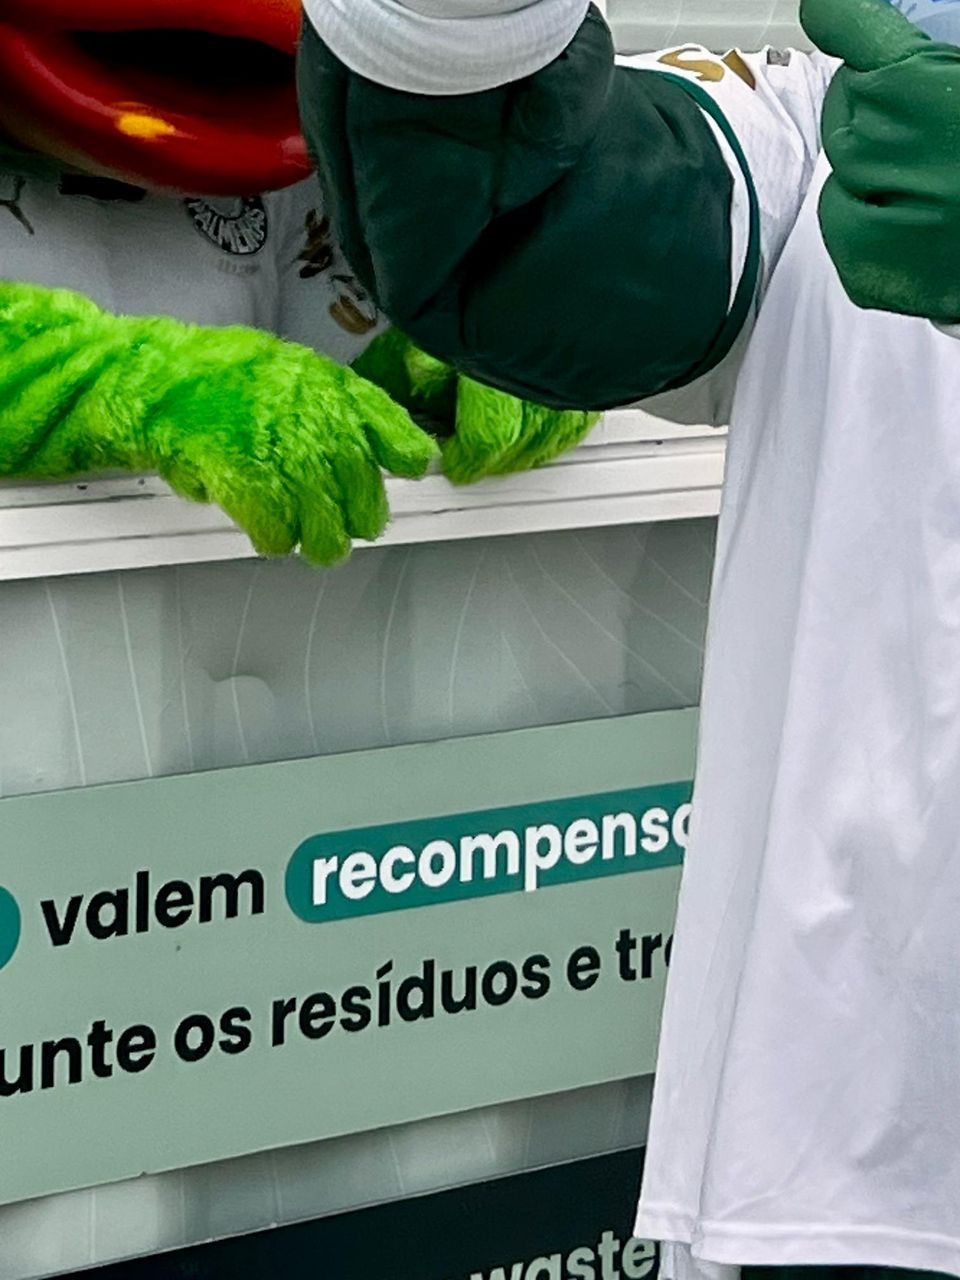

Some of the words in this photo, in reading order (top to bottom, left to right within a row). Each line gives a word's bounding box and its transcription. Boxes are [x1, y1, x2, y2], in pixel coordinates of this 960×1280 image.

[40, 867, 265, 947] valem
[173, 1005, 252, 1064] os
[271, 953, 551, 1047] resíduos
[566, 944, 601, 992] e
[615, 927, 673, 983] tr
